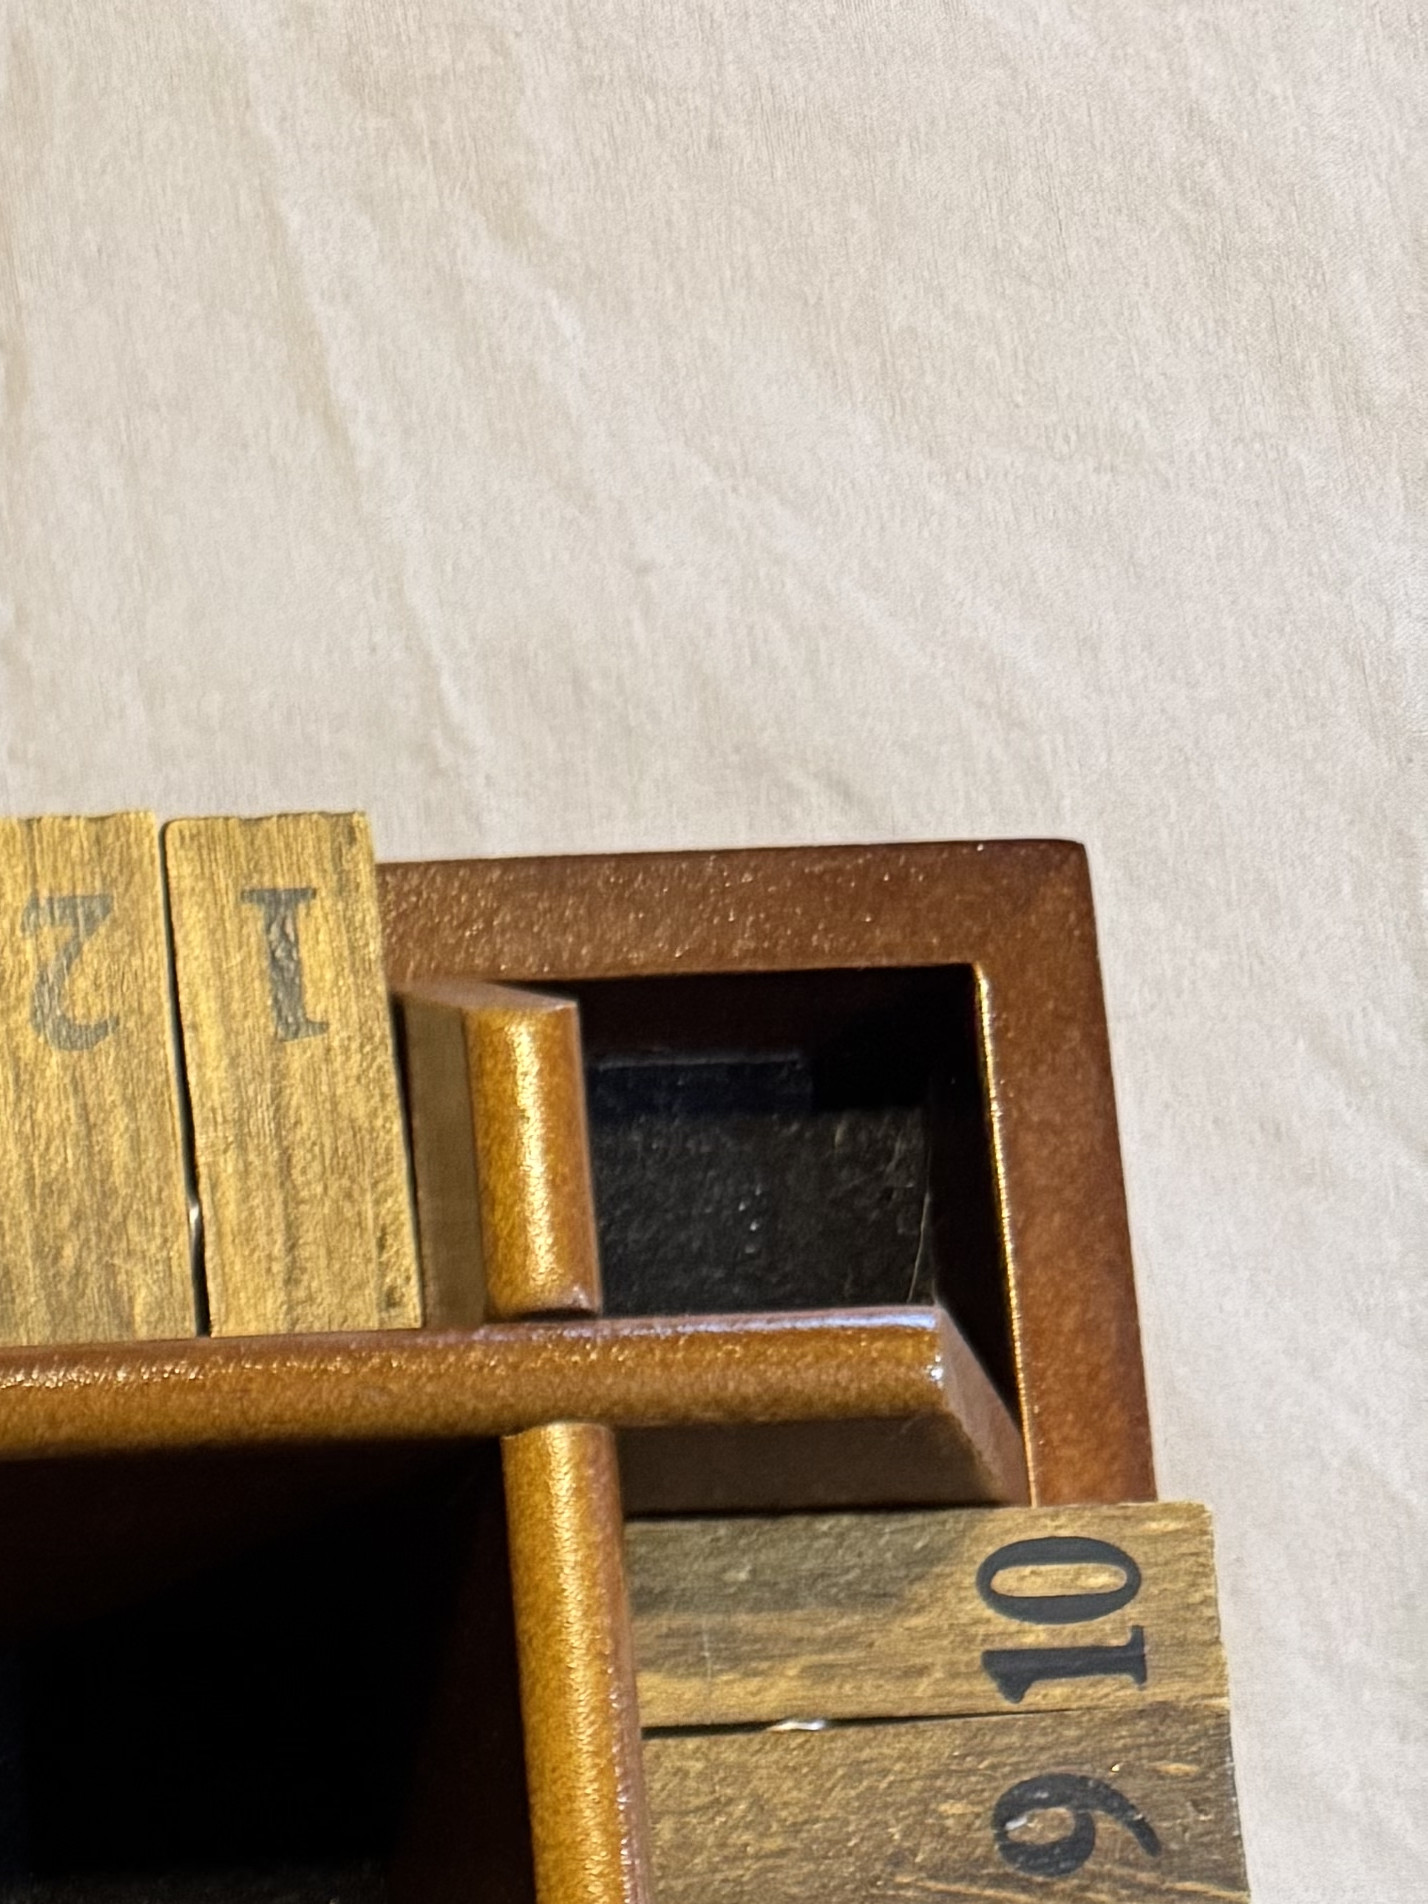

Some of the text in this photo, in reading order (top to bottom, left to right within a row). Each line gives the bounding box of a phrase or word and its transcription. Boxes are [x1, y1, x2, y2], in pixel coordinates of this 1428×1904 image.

[21, 894, 118, 1052] 2
[239, 888, 328, 1041] 1
[976, 1535, 1146, 1703] 10
[991, 1774, 1161, 1877] 9
